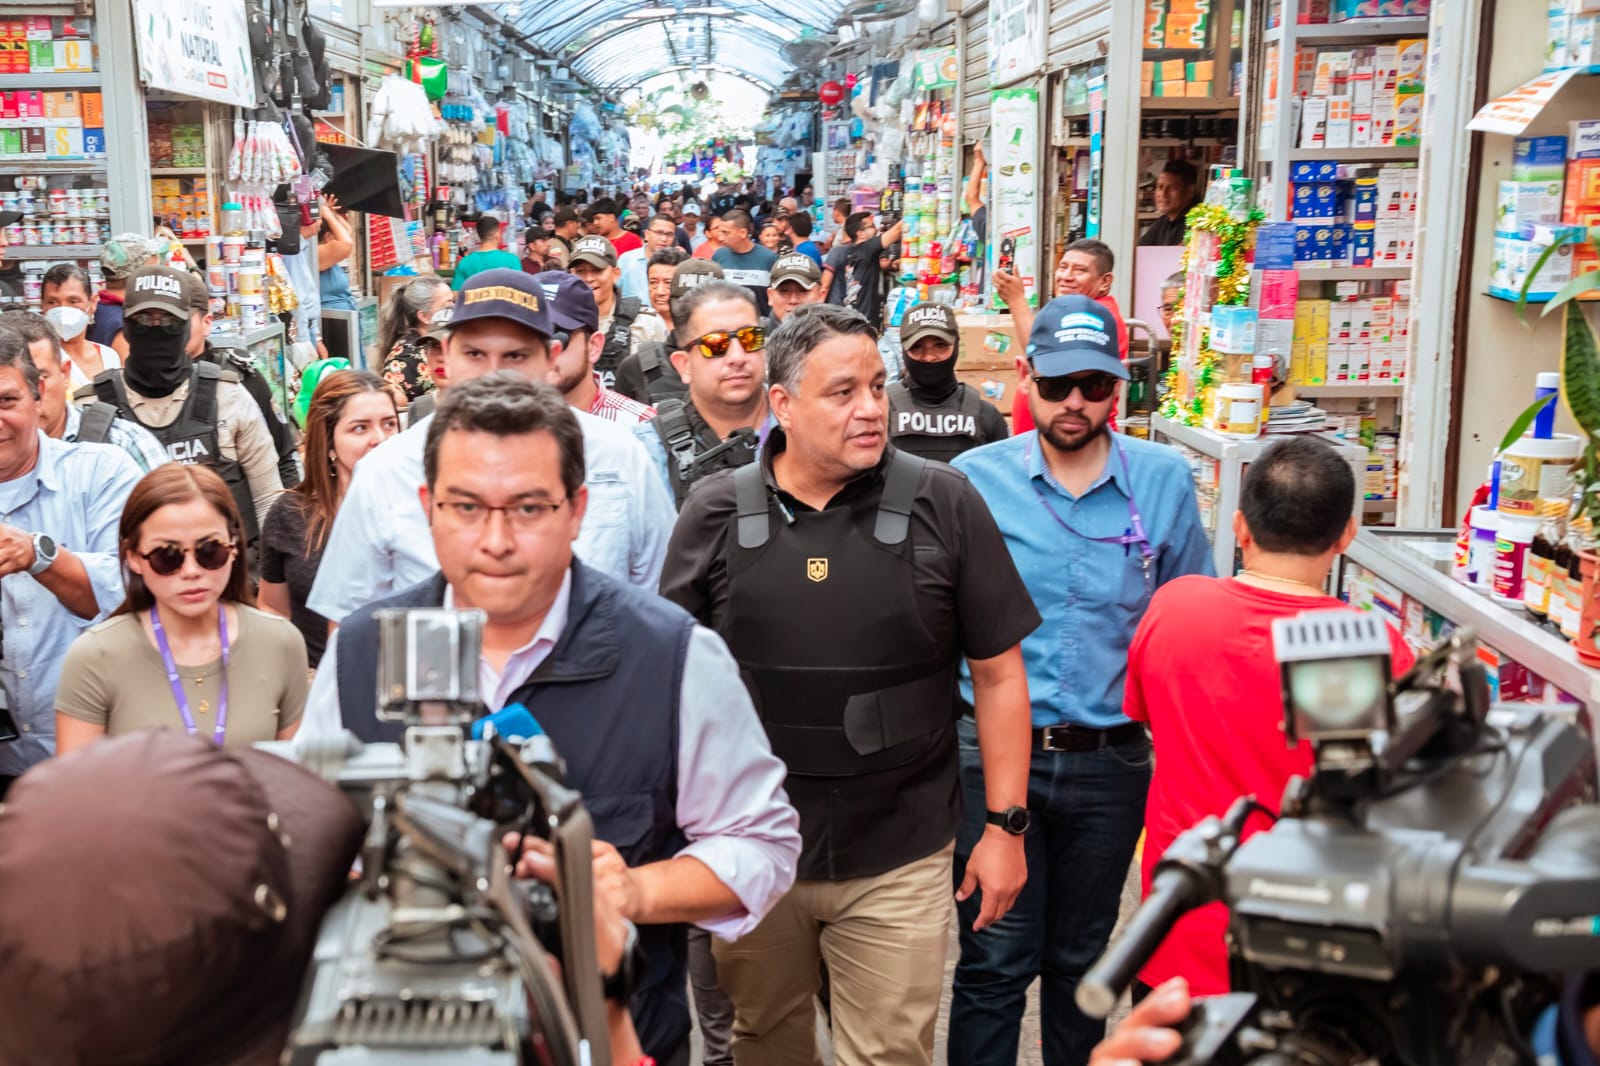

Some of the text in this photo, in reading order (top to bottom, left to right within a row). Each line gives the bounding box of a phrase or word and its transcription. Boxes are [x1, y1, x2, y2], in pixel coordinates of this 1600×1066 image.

[135, 274, 182, 294] POLICÍA
[908, 304, 948, 325] POLICÍA
[898, 412, 976, 436] POLICIA
